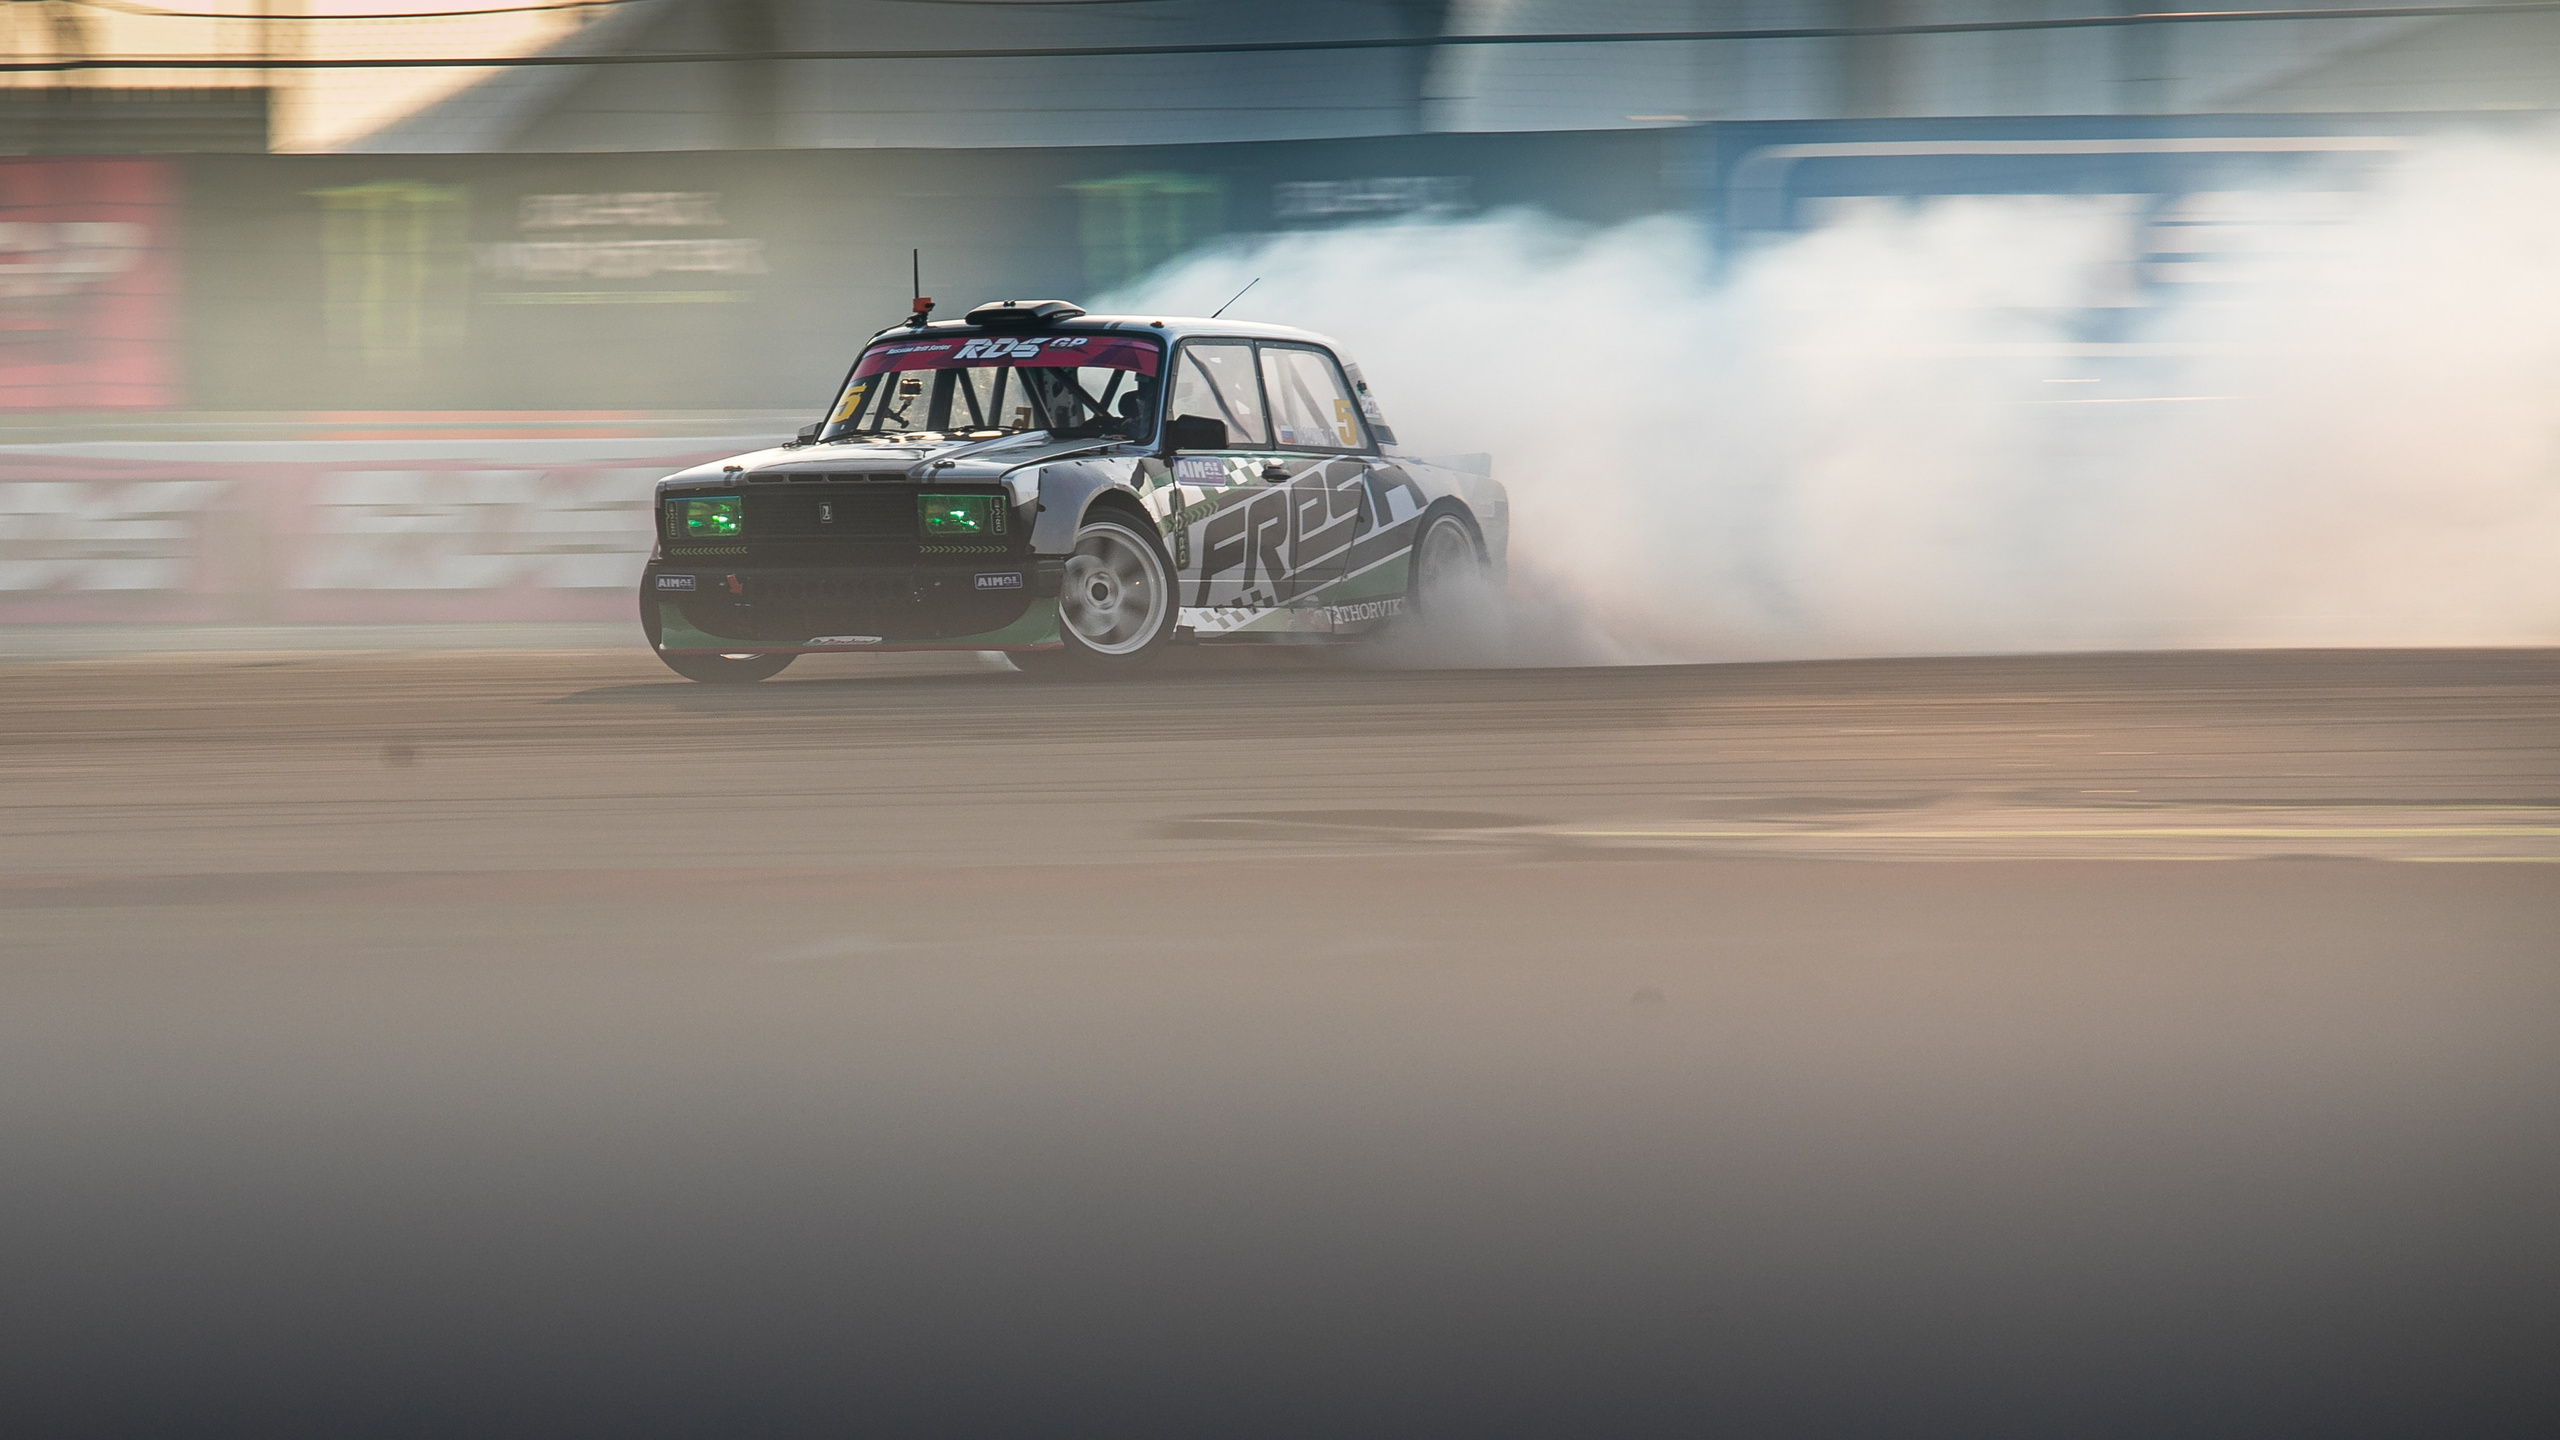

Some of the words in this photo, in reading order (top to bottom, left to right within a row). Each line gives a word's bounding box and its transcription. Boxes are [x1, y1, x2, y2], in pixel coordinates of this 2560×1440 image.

[952, 338, 1052, 360] RDS
[1050, 337, 1089, 348] GP
[830, 385, 868, 424] 5
[1333, 398, 1358, 446] 5
[1178, 460, 1223, 479] AIMOL
[977, 576, 1020, 587] AIMOL
[1340, 598, 1402, 623] THORVIK
